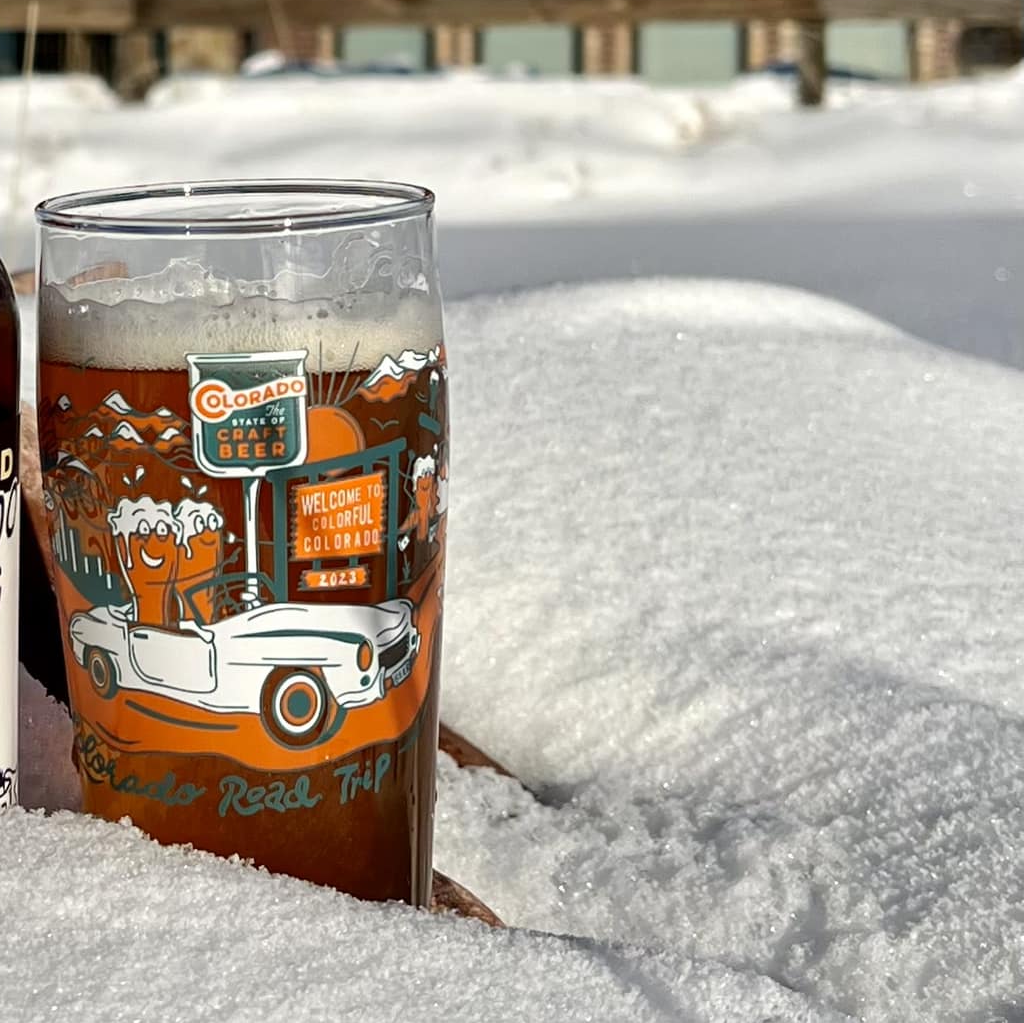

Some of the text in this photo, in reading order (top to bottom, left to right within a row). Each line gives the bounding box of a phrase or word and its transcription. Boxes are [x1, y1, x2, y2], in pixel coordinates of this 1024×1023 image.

[196, 380, 304, 419] COLORADO
[265, 402, 285, 417] The
[232, 416, 285, 427] STATE OF
[217, 426, 287, 441] CRAFT
[219, 442, 285, 459] BEER
[301, 483, 381, 516] WELCOME TO
[312, 503, 374, 531] COLORFUL
[303, 529, 379, 552] COLORADO
[319, 571, 357, 587] 2023
[218, 775, 323, 818] Road
